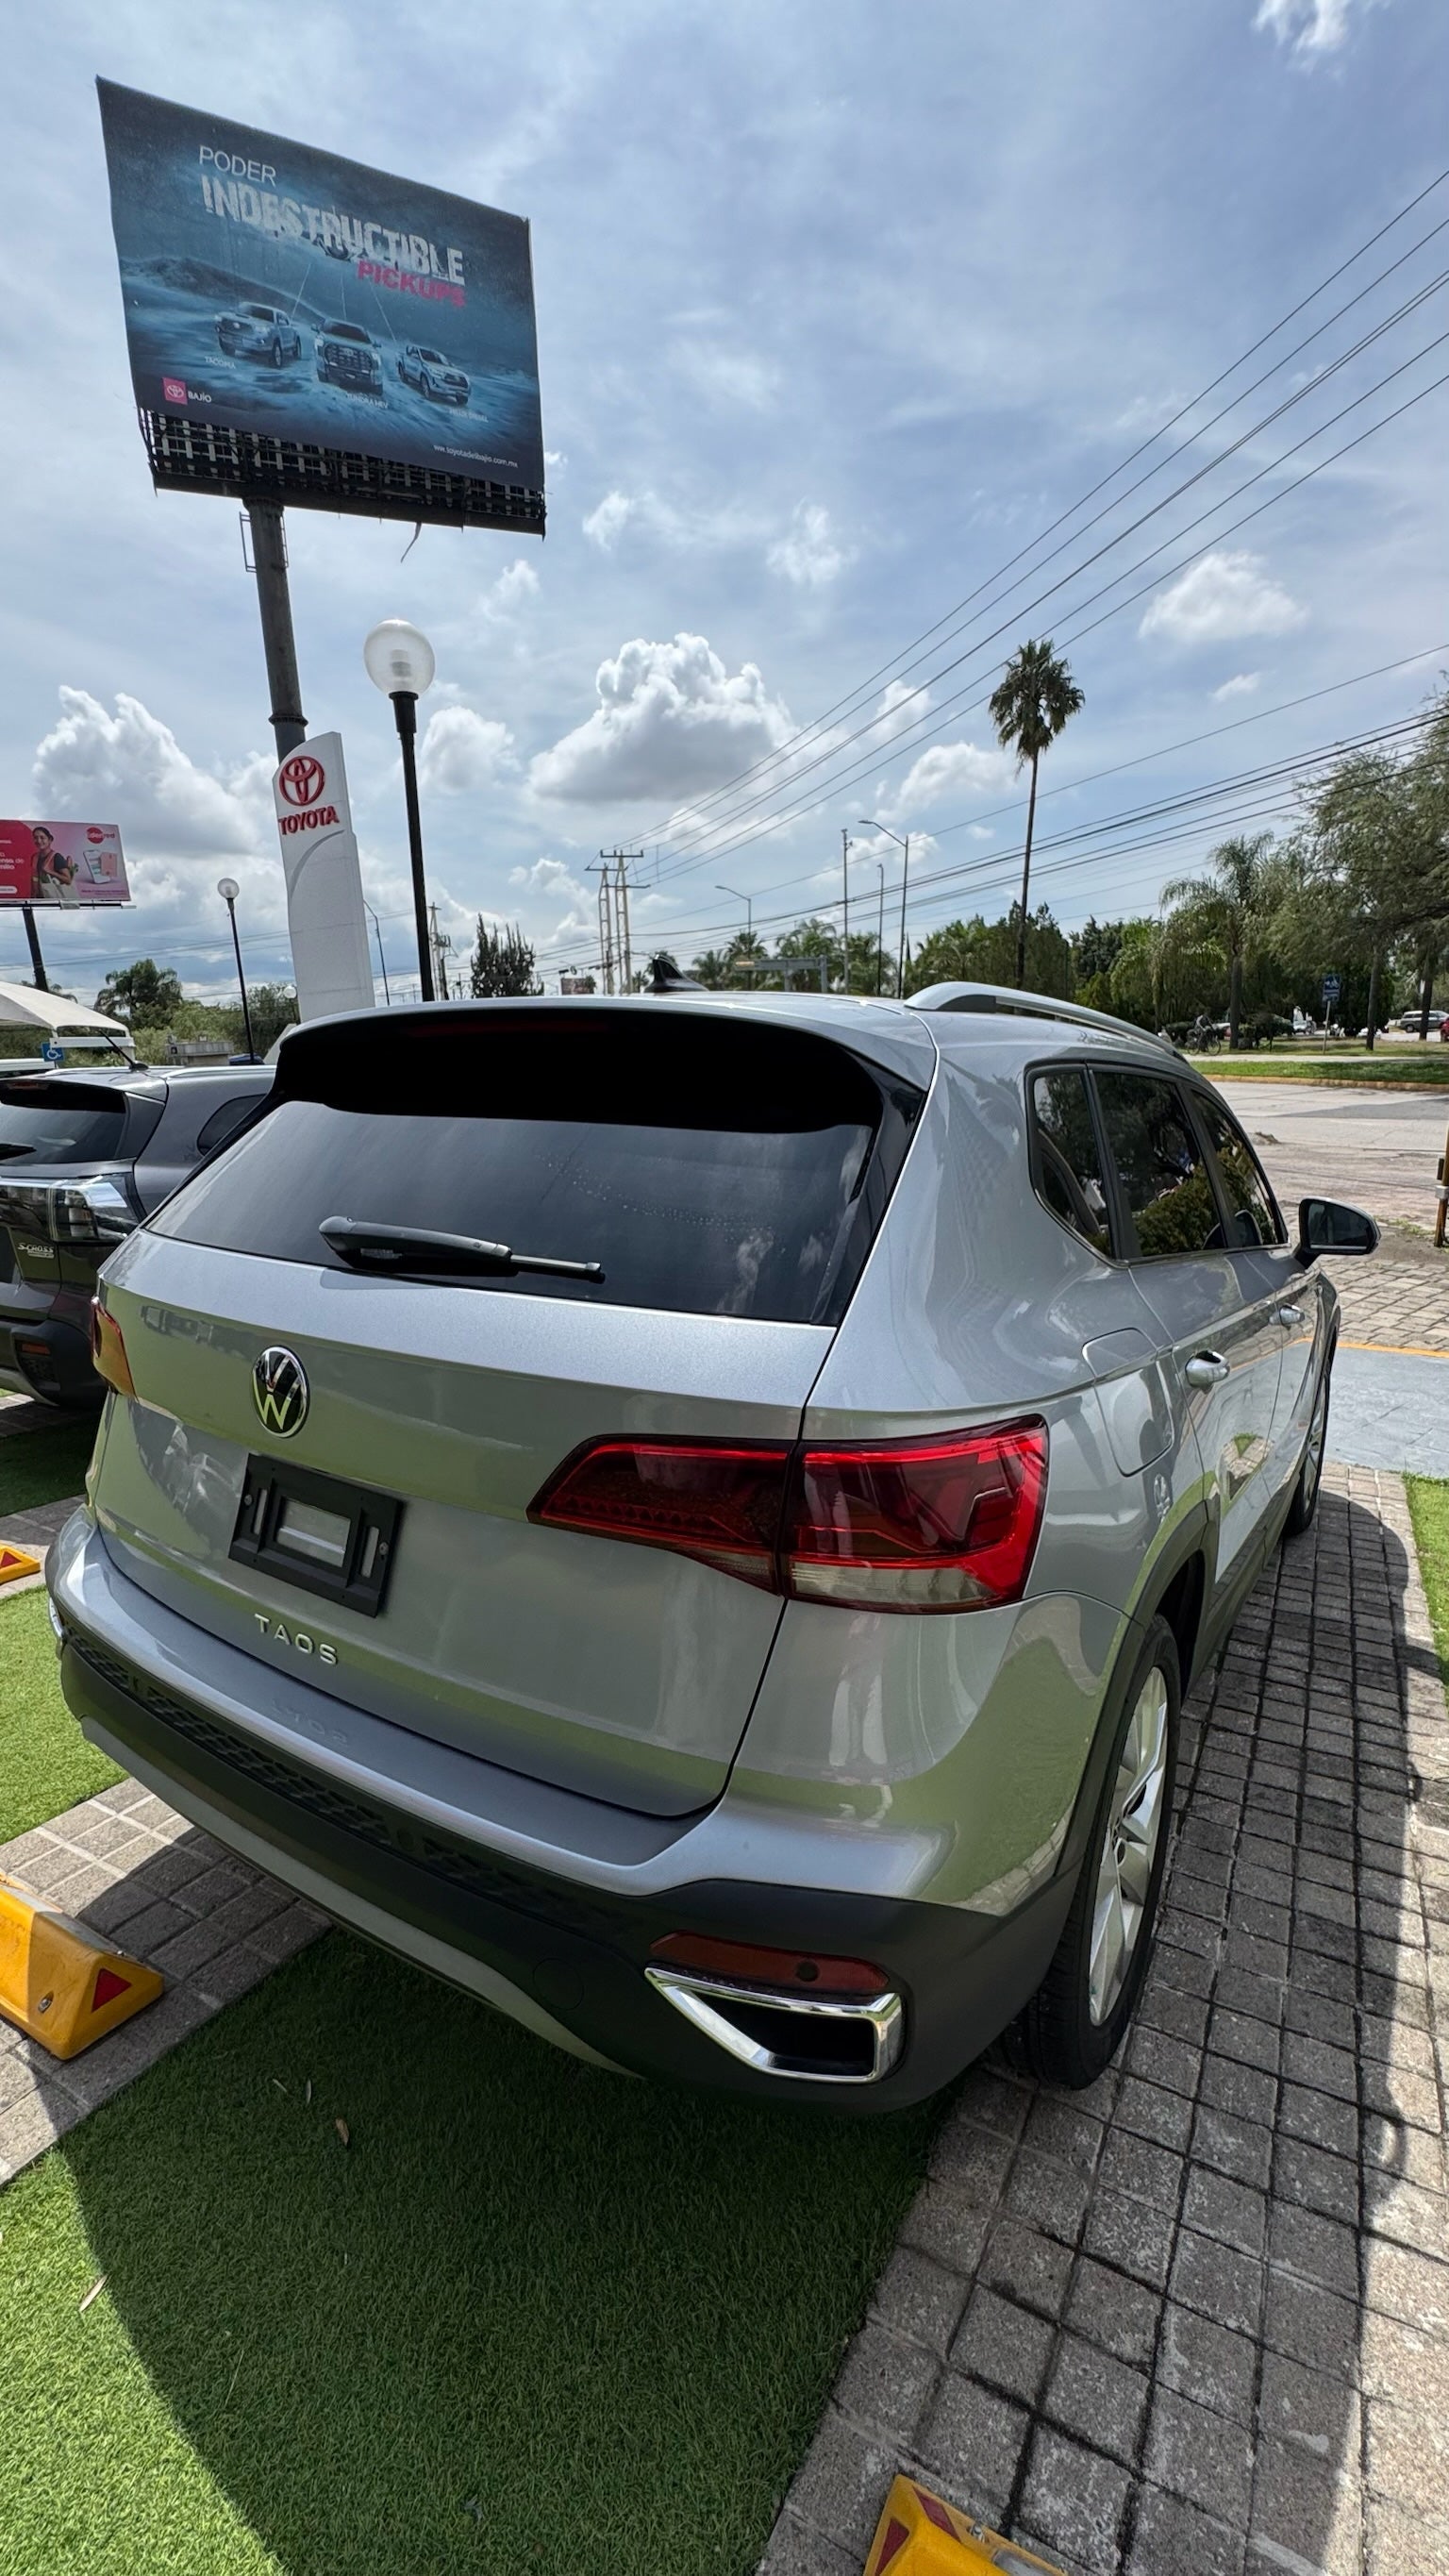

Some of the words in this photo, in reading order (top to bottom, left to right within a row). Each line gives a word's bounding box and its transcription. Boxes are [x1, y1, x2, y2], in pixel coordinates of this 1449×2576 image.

[199, 145, 277, 187] PODER
[201, 174, 466, 286] INDESTRUCTIBLE
[357, 259, 466, 309] PICKUPS
[205, 356, 236, 369] TACOMA
[278, 805, 341, 836] TOYOTA
[18, 1242, 54, 1253] S-CROSS
[254, 1613, 339, 1665] TAOS
